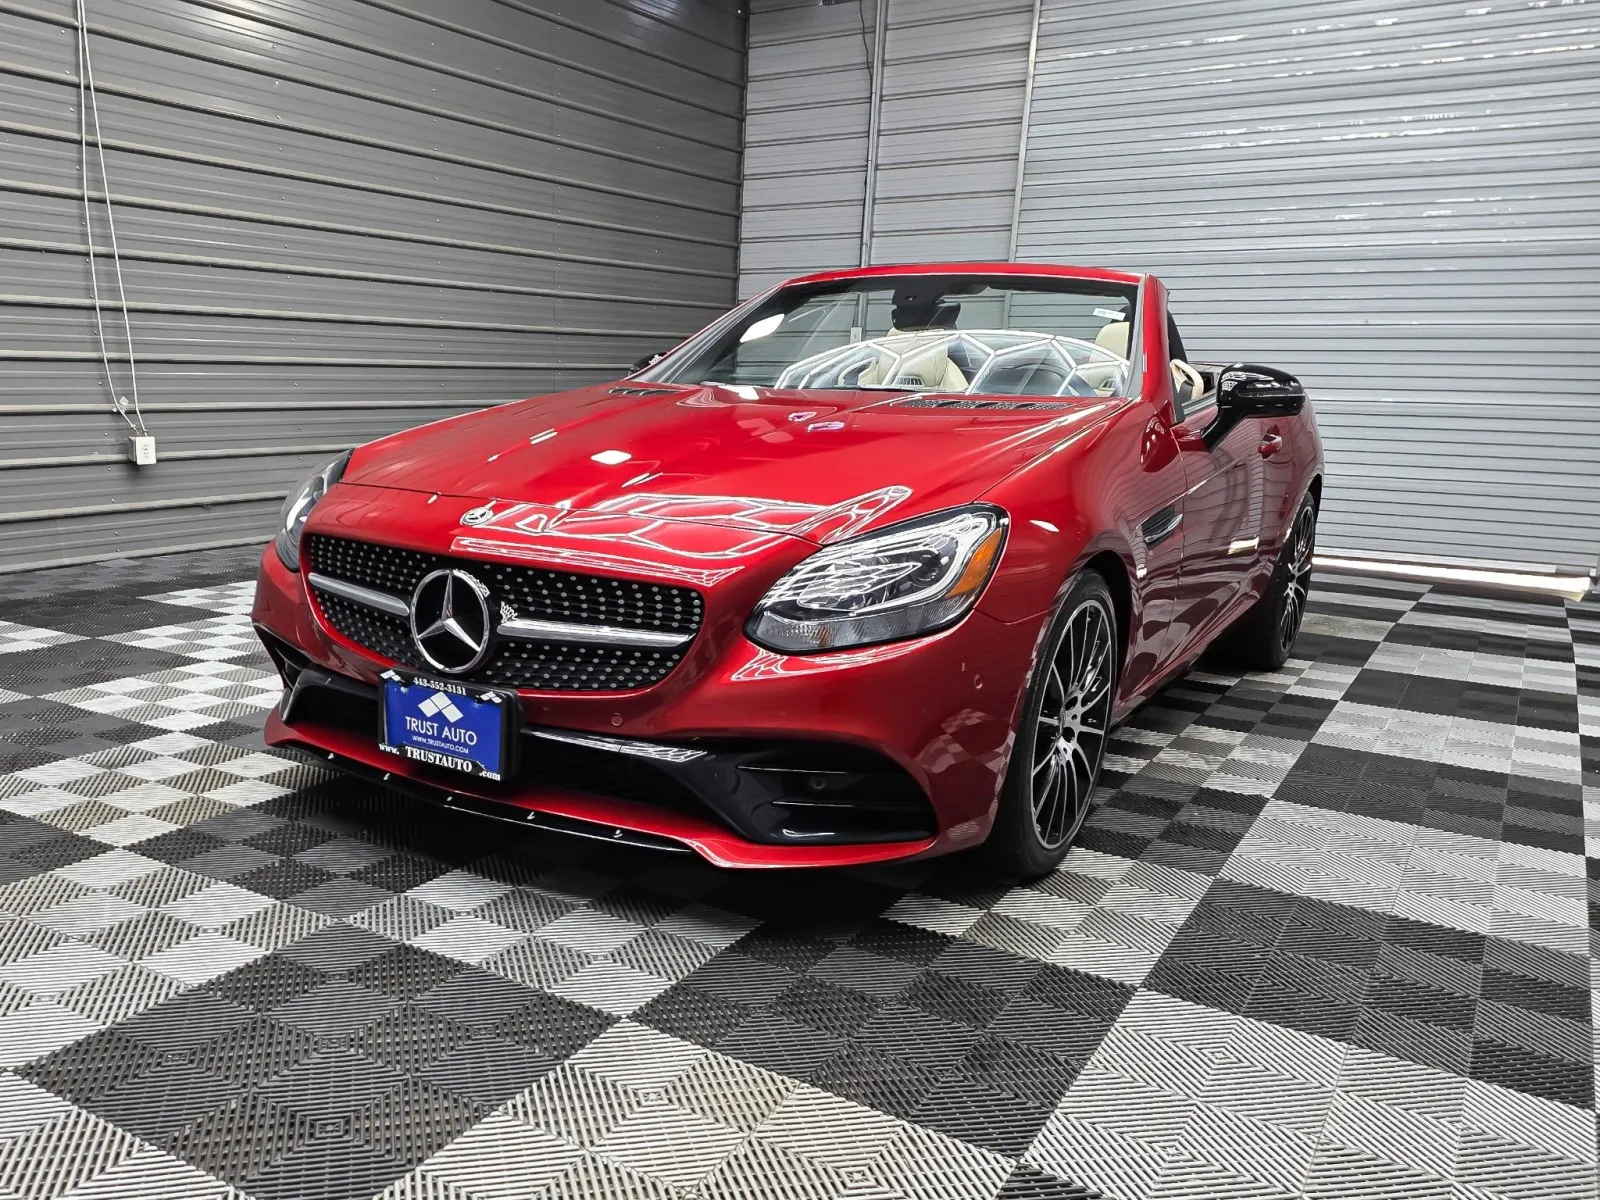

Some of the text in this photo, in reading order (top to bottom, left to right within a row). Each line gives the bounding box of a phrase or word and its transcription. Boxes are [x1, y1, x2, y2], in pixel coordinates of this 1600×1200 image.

[413, 677, 467, 696] 443-552-3131
[405, 716, 477, 745] TRUST AUTO
[412, 735, 469, 754] WWW.TRUSTAUTO.COM
[378, 743, 501, 781] www. TRUSTAUTO .com
